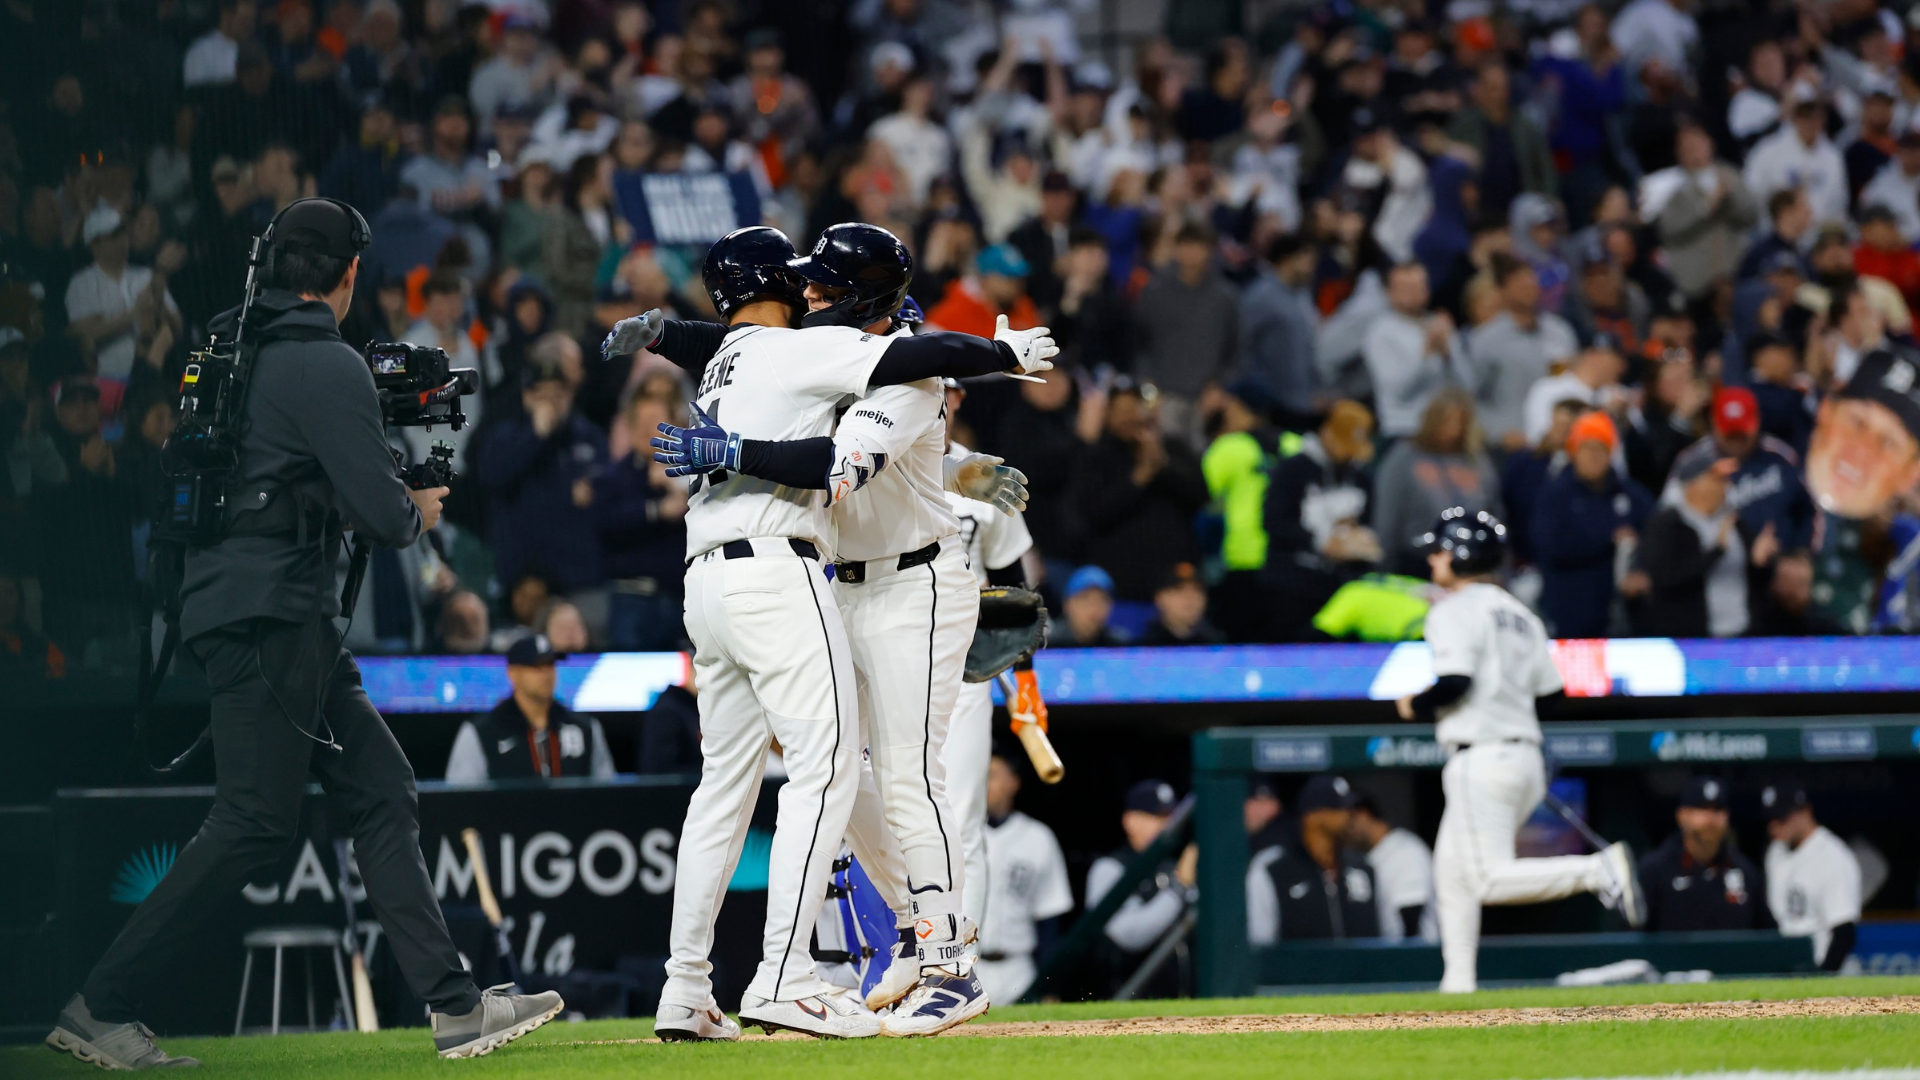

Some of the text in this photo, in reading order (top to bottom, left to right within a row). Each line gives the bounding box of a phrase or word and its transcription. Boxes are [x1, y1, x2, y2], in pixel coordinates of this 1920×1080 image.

[713, 289, 724, 301] 31
[698, 351, 741, 401] EENE
[855, 409, 895, 429] meijer
[851, 450, 862, 462] 20
[241, 828, 677, 904] ASMIGOS
[970, 979, 982, 994] 20
